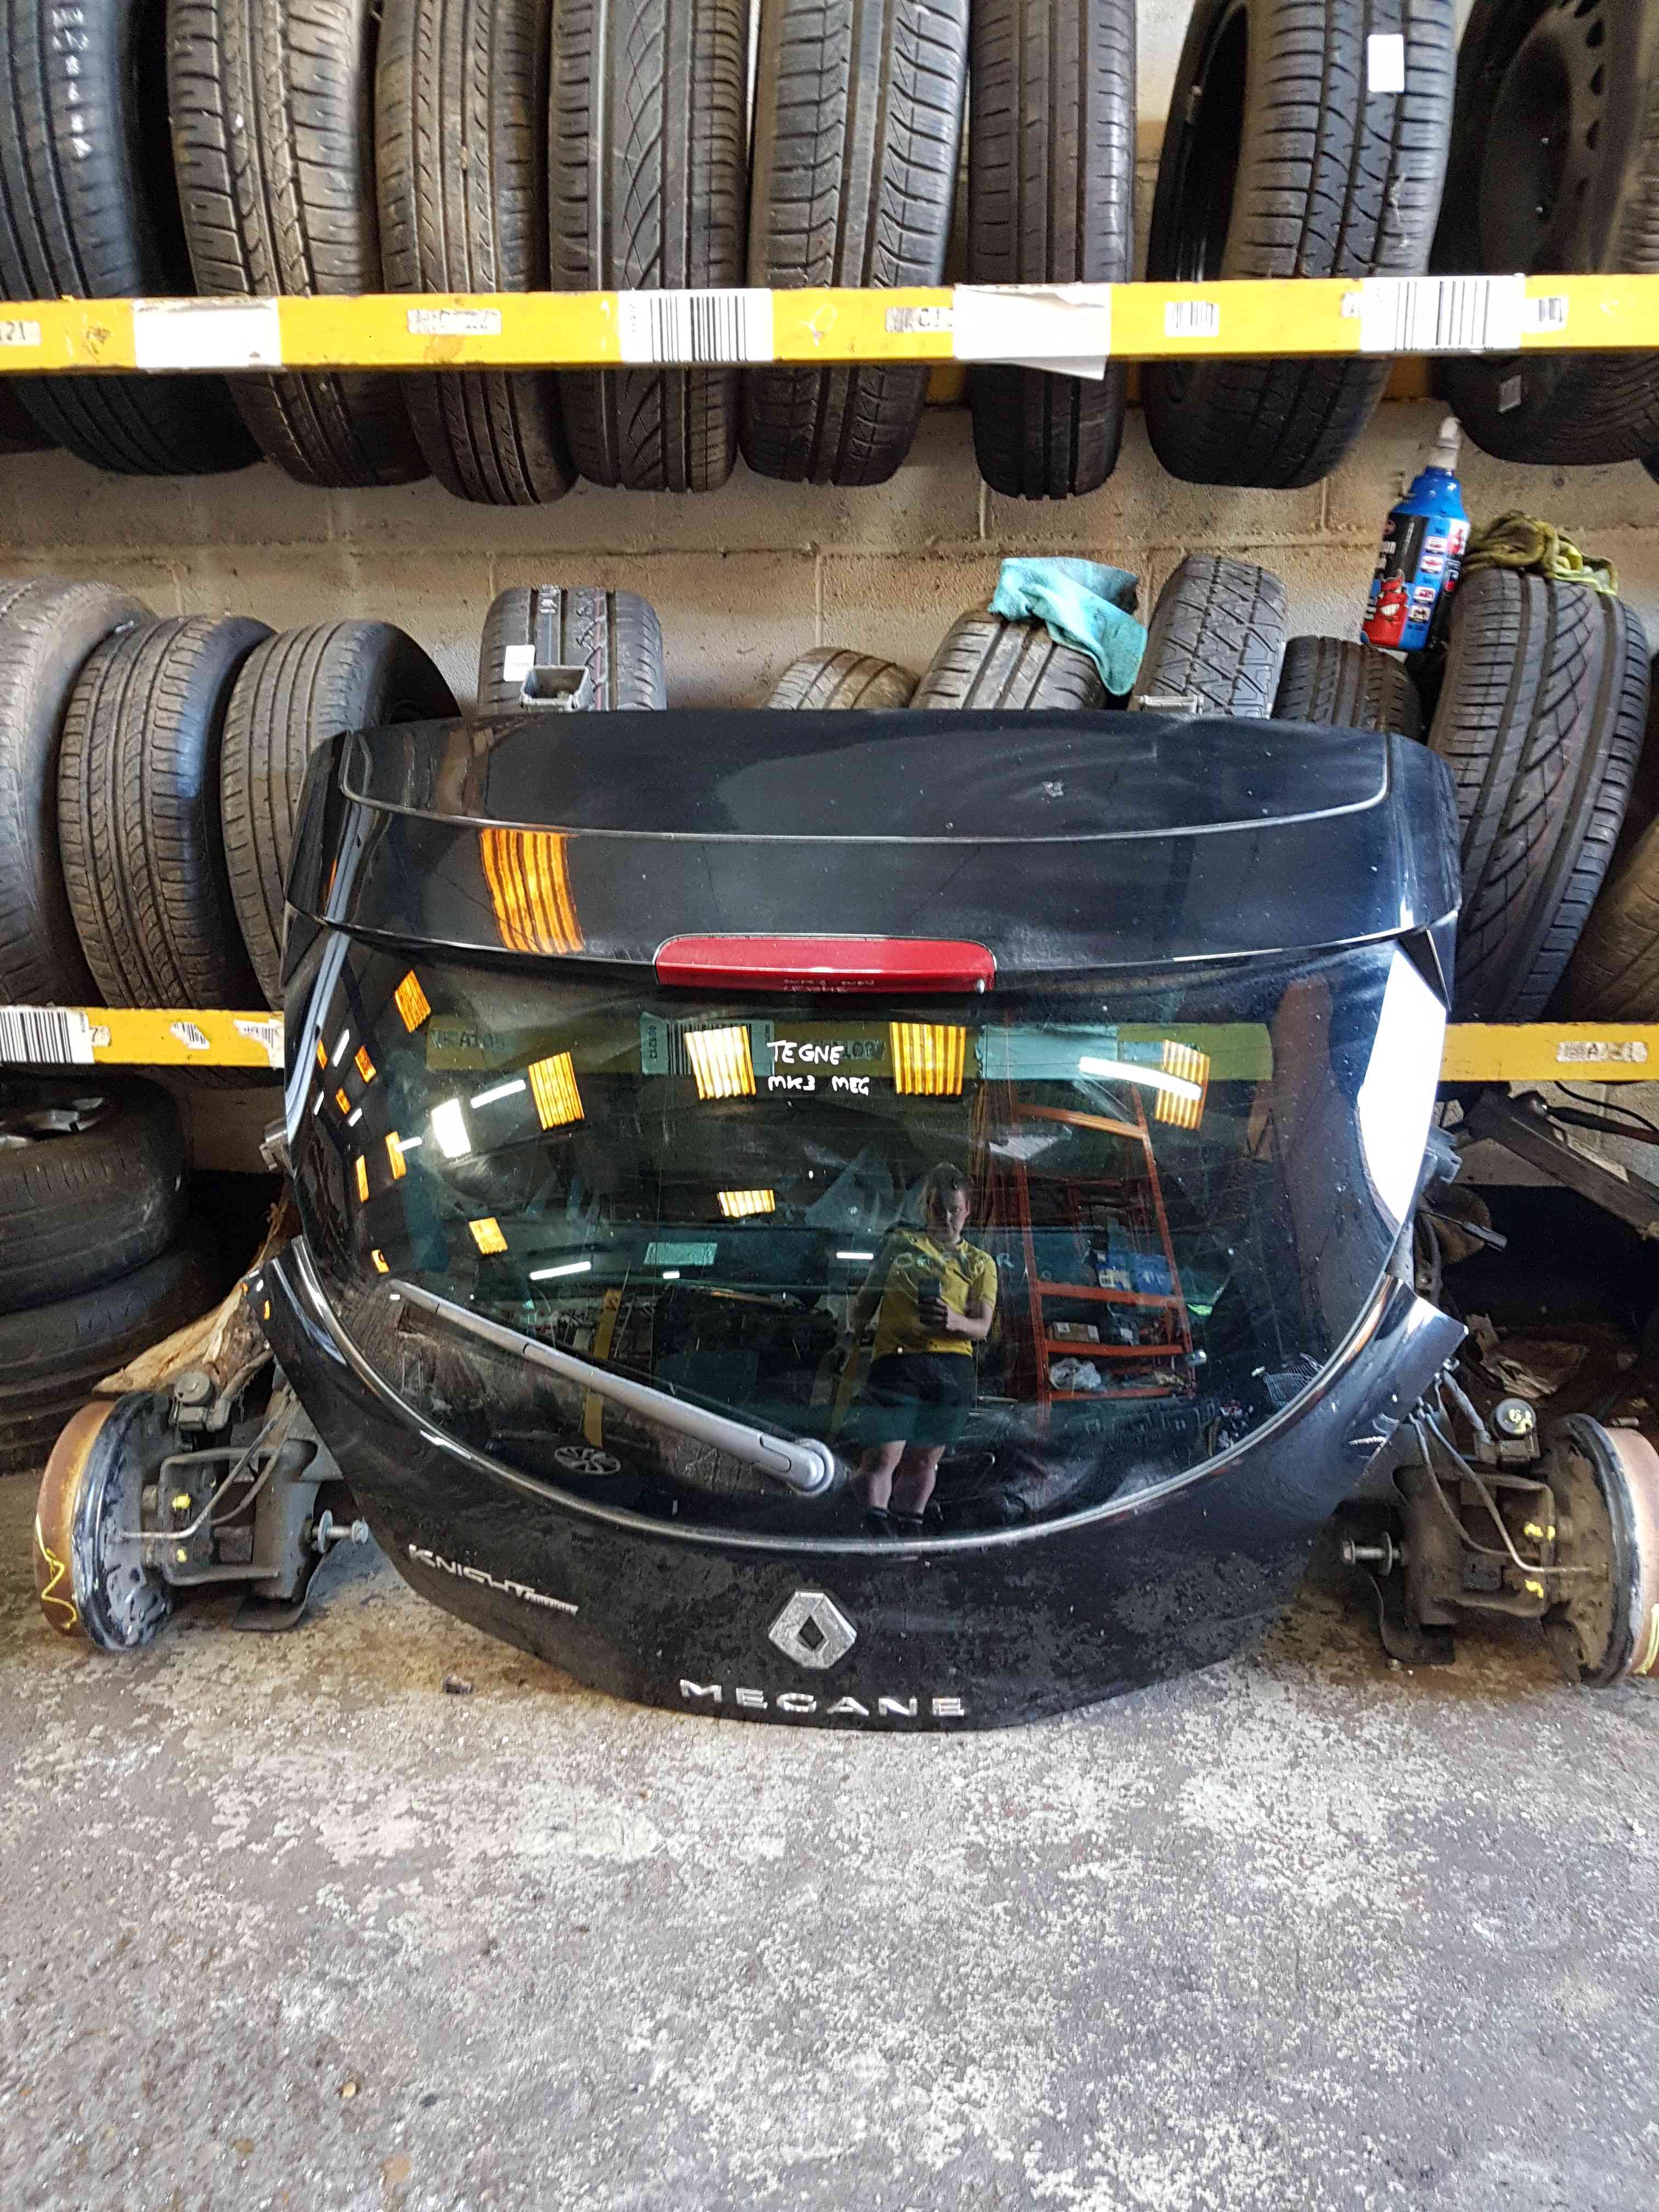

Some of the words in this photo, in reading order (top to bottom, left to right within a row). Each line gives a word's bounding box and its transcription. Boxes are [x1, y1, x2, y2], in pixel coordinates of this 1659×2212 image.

[766, 1040, 844, 1065] TEGNE
[831, 1075, 870, 1096] MEG
[680, 1679, 965, 1717] MEGANE
